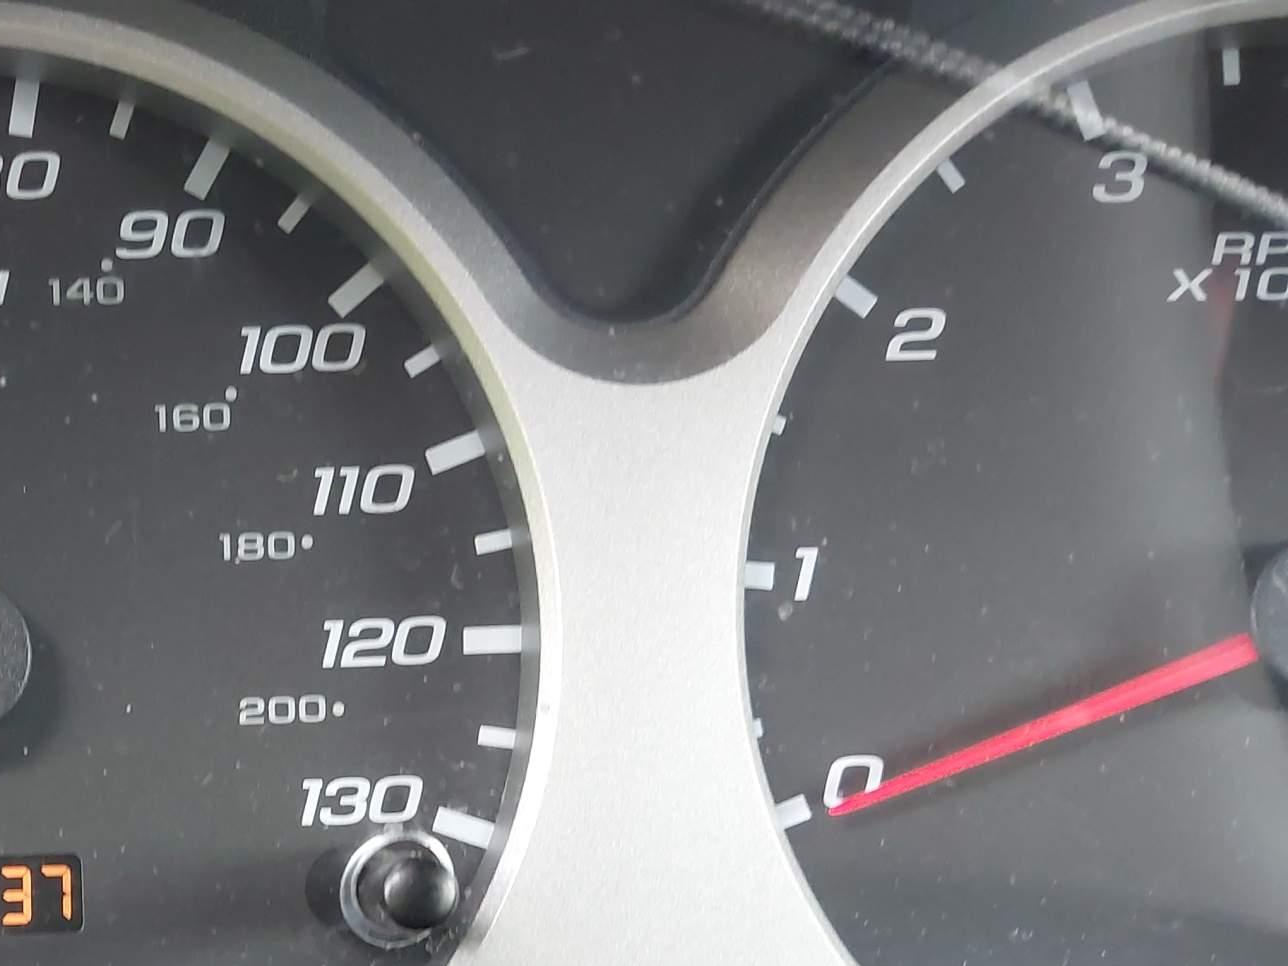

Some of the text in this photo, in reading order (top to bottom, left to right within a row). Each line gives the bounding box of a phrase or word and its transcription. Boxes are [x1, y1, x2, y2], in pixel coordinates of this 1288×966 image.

[1092, 152, 1149, 203] 3
[115, 209, 226, 260] 90
[47, 277, 125, 306] 140
[238, 323, 367, 375] 100
[885, 307, 948, 362] 2
[153, 402, 232, 433] 160
[312, 464, 415, 517] 110
[218, 531, 296, 562] 180
[793, 546, 819, 602] 1
[320, 615, 447, 669] 120
[238, 694, 328, 726] 200
[300, 774, 424, 828] 130
[823, 755, 884, 811] 0
